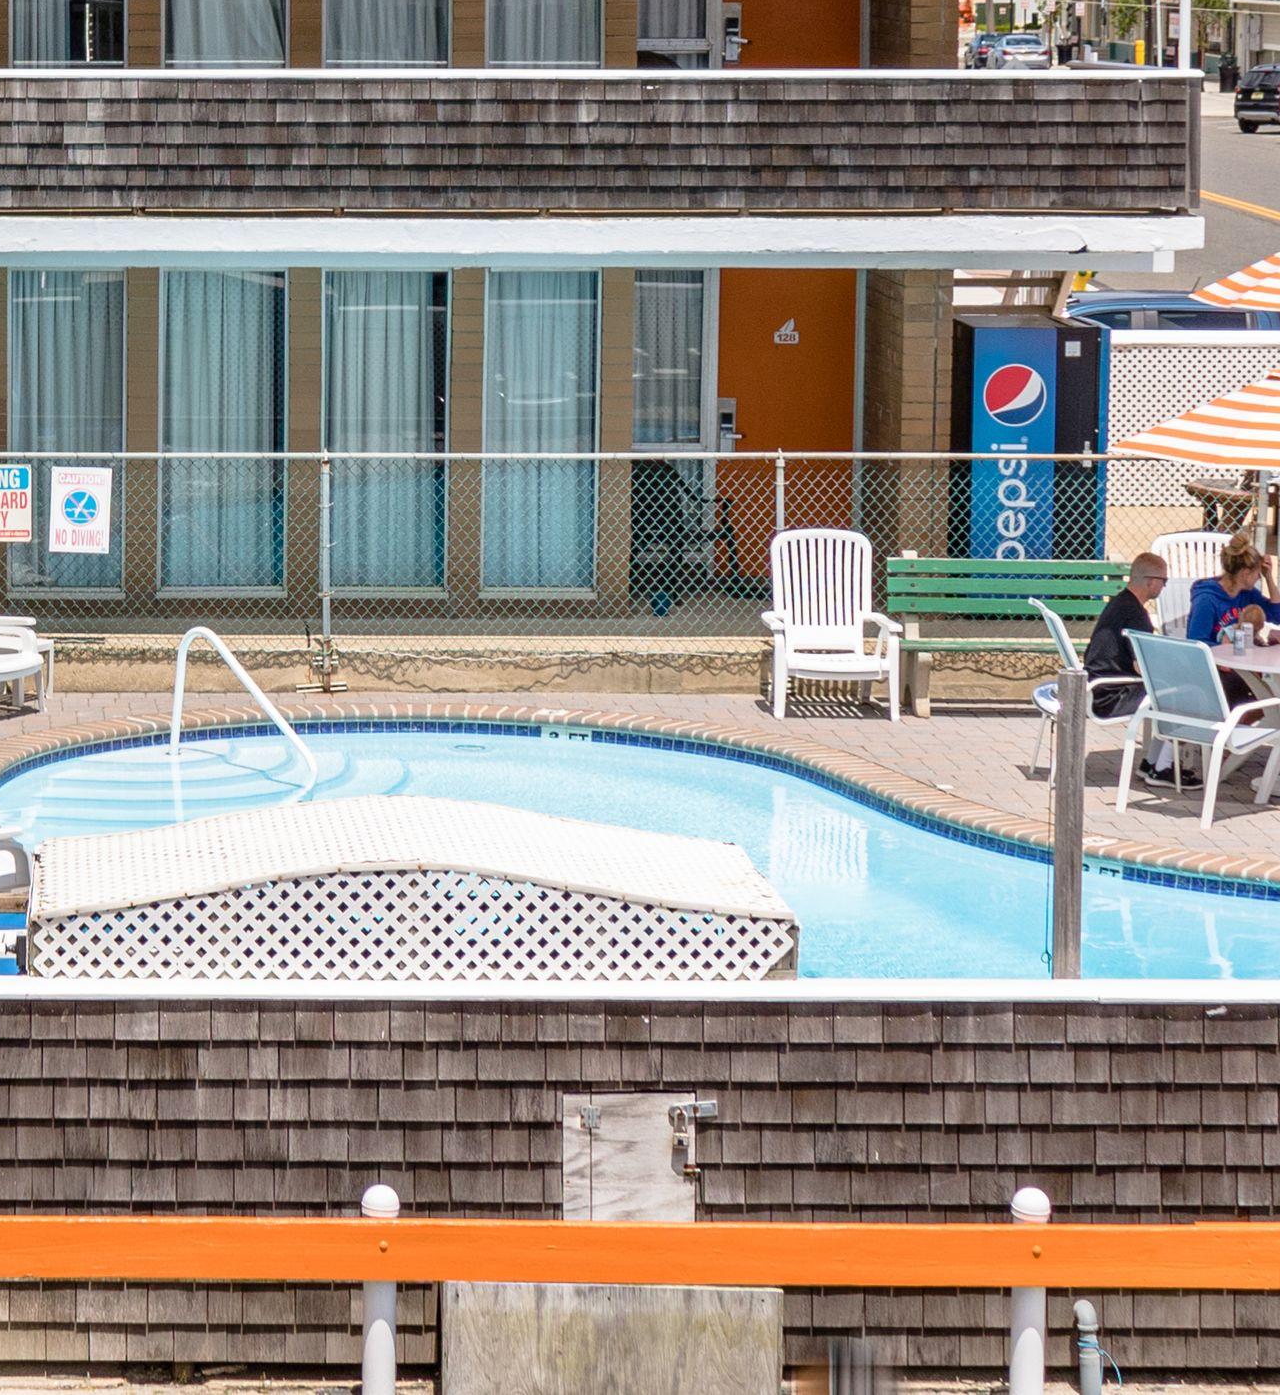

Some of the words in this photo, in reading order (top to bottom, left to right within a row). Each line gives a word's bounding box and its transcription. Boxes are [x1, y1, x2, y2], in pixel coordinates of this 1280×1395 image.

[777, 333, 796, 342] 128
[59, 473, 105, 485] CAUTION!
[55, 529, 67, 545] NO
[71, 529, 104, 546] DIVING!
